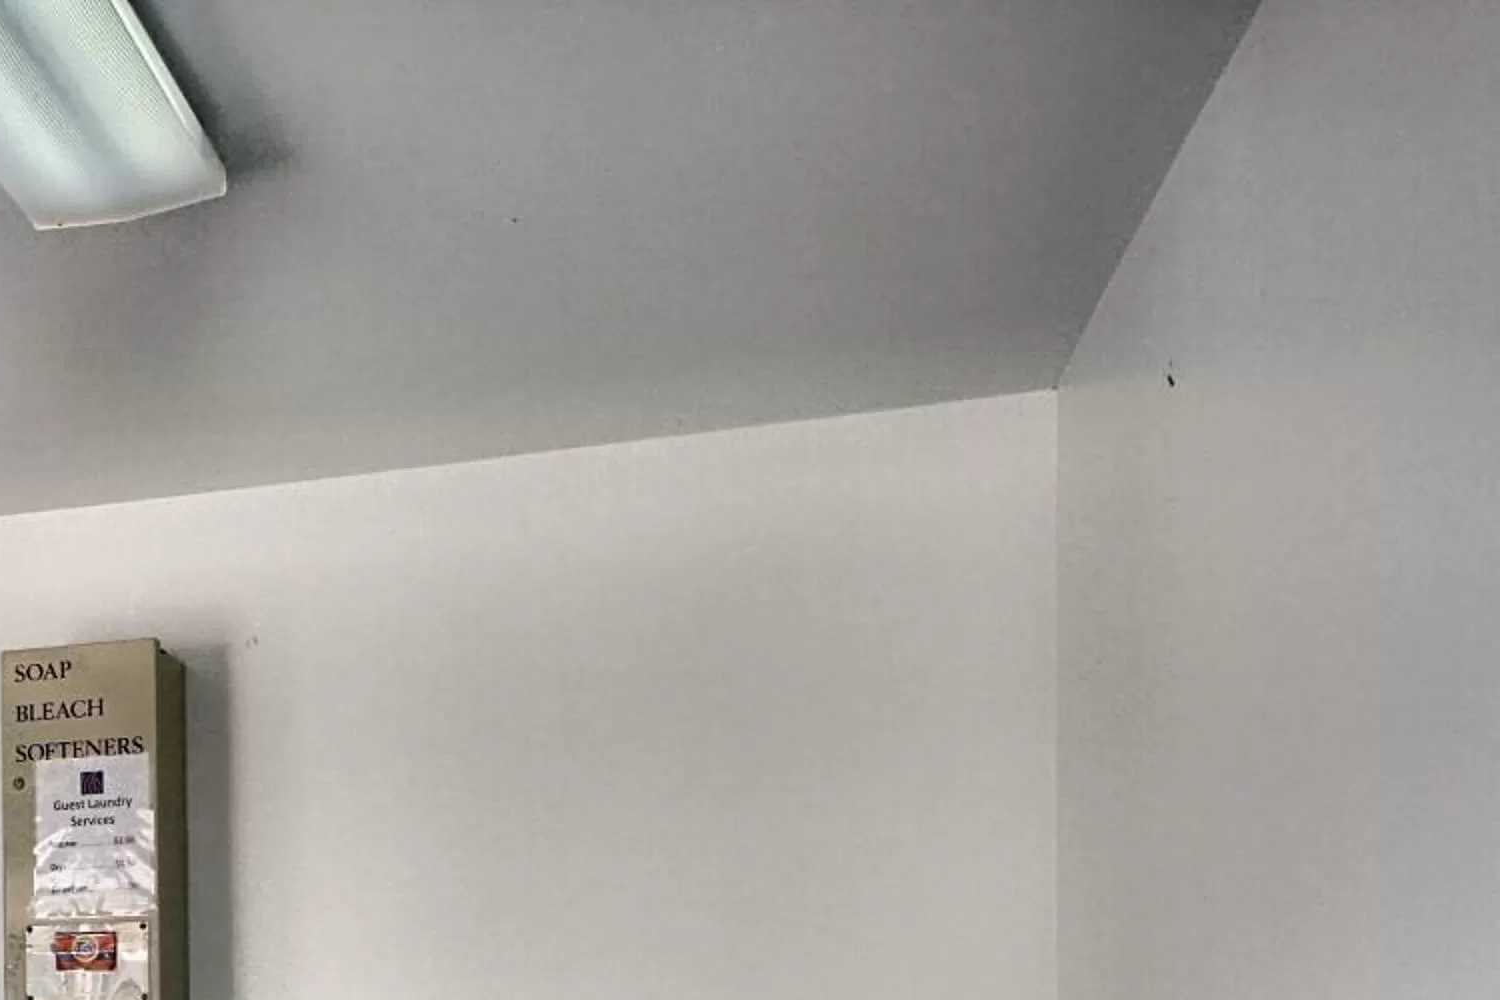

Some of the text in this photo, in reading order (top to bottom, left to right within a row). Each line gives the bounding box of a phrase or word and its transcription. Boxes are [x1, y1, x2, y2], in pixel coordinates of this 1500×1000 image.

[14, 661, 72, 683] SOAP
[15, 698, 104, 723] BLEACH
[15, 736, 145, 763] SOFTENERS
[53, 796, 133, 811] Guest Laundry
[70, 815, 116, 827] Services
